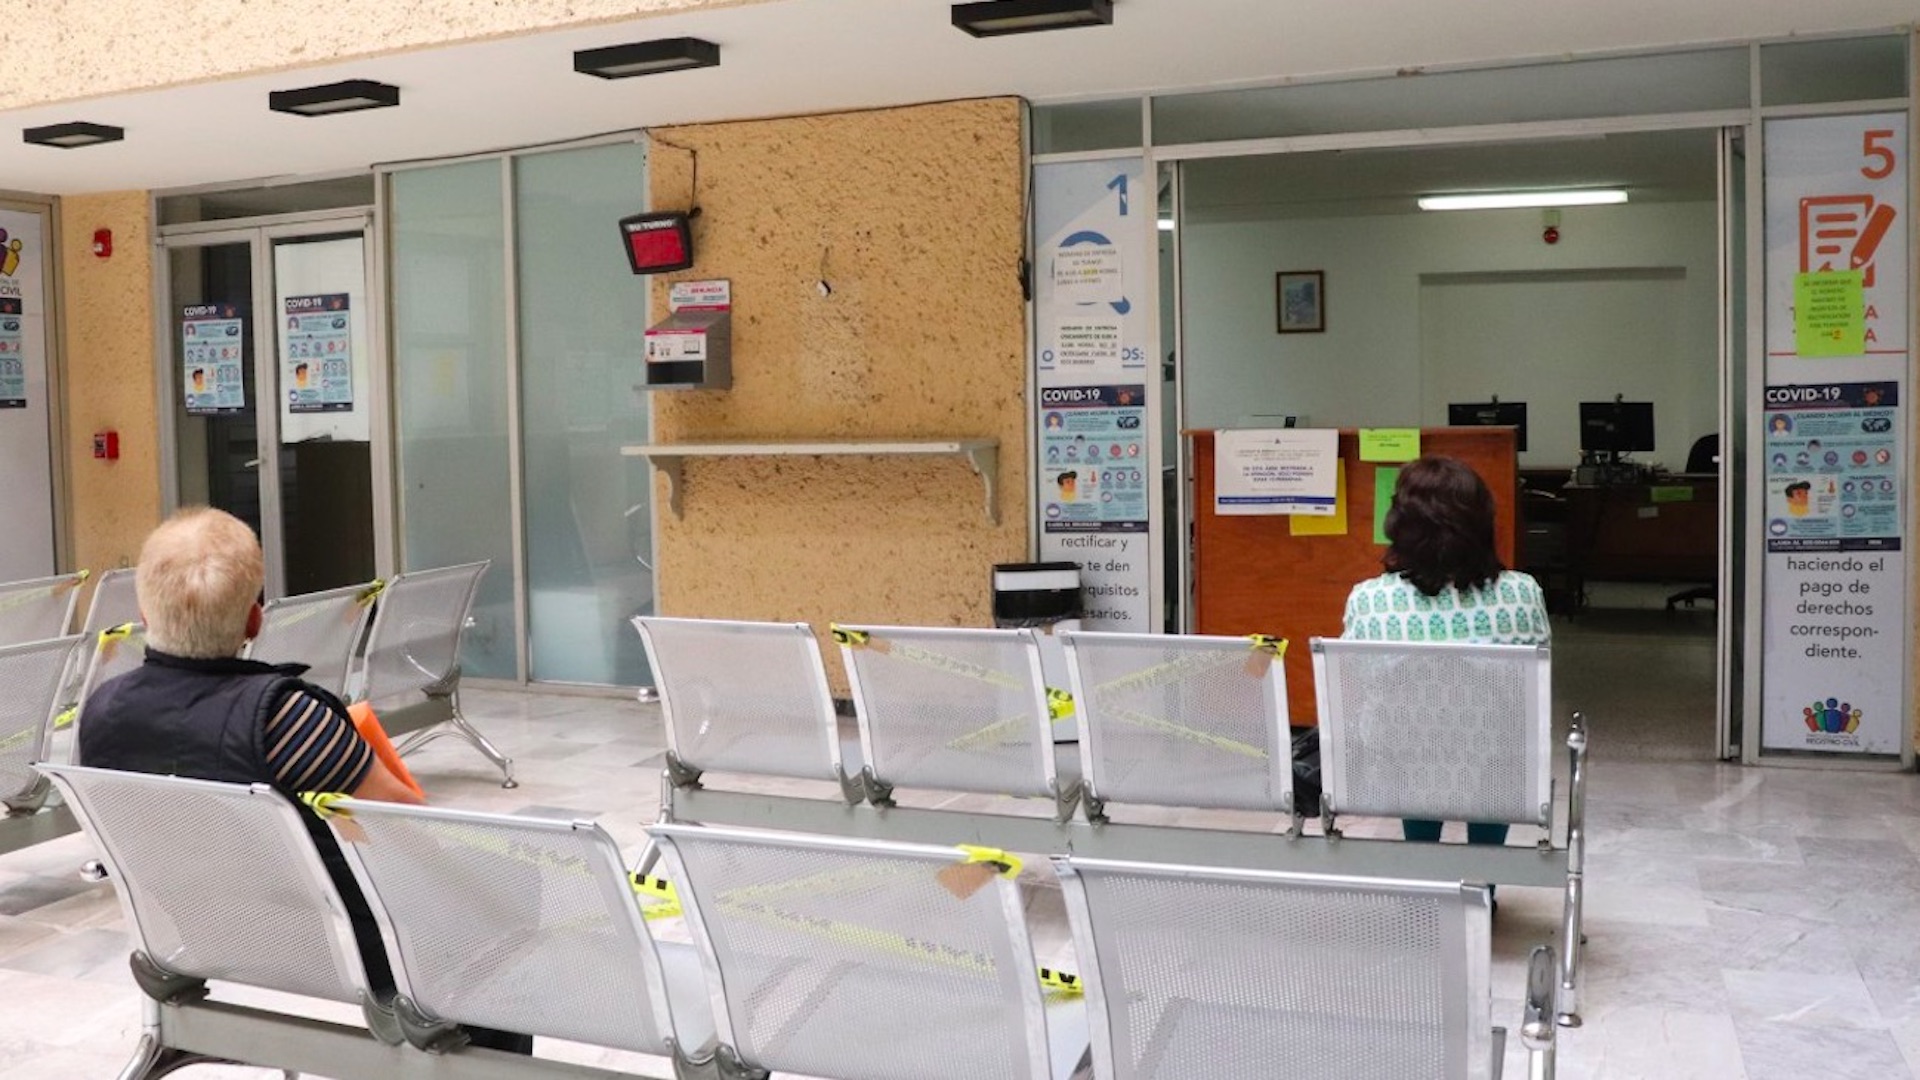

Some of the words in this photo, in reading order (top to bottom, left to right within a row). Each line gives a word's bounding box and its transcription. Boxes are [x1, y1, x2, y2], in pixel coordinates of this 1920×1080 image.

[1861, 129, 1896, 180] 5
[1107, 173, 1128, 216] 1
[183, 305, 217, 317] COVID-19
[286, 297, 322, 309] COVID-19
[1043, 388, 1101, 402] COVID-19
[1766, 386, 1842, 403] COVID-19
[1061, 535, 1117, 548] rectificar
[1120, 537, 1129, 552] y
[1087, 560, 1101, 572] te
[1105, 557, 1130, 572] den
[1787, 556, 1863, 572] haciendo
[1869, 558, 1884, 572] el
[1085, 582, 1139, 600] quisitos
[1799, 582, 1843, 597] pago
[1848, 579, 1870, 594] de
[1081, 604, 1132, 621] esarios.
[1796, 600, 1874, 616] derechos
[1790, 623, 1879, 641] correspon-
[1805, 643, 1862, 659] diente.
